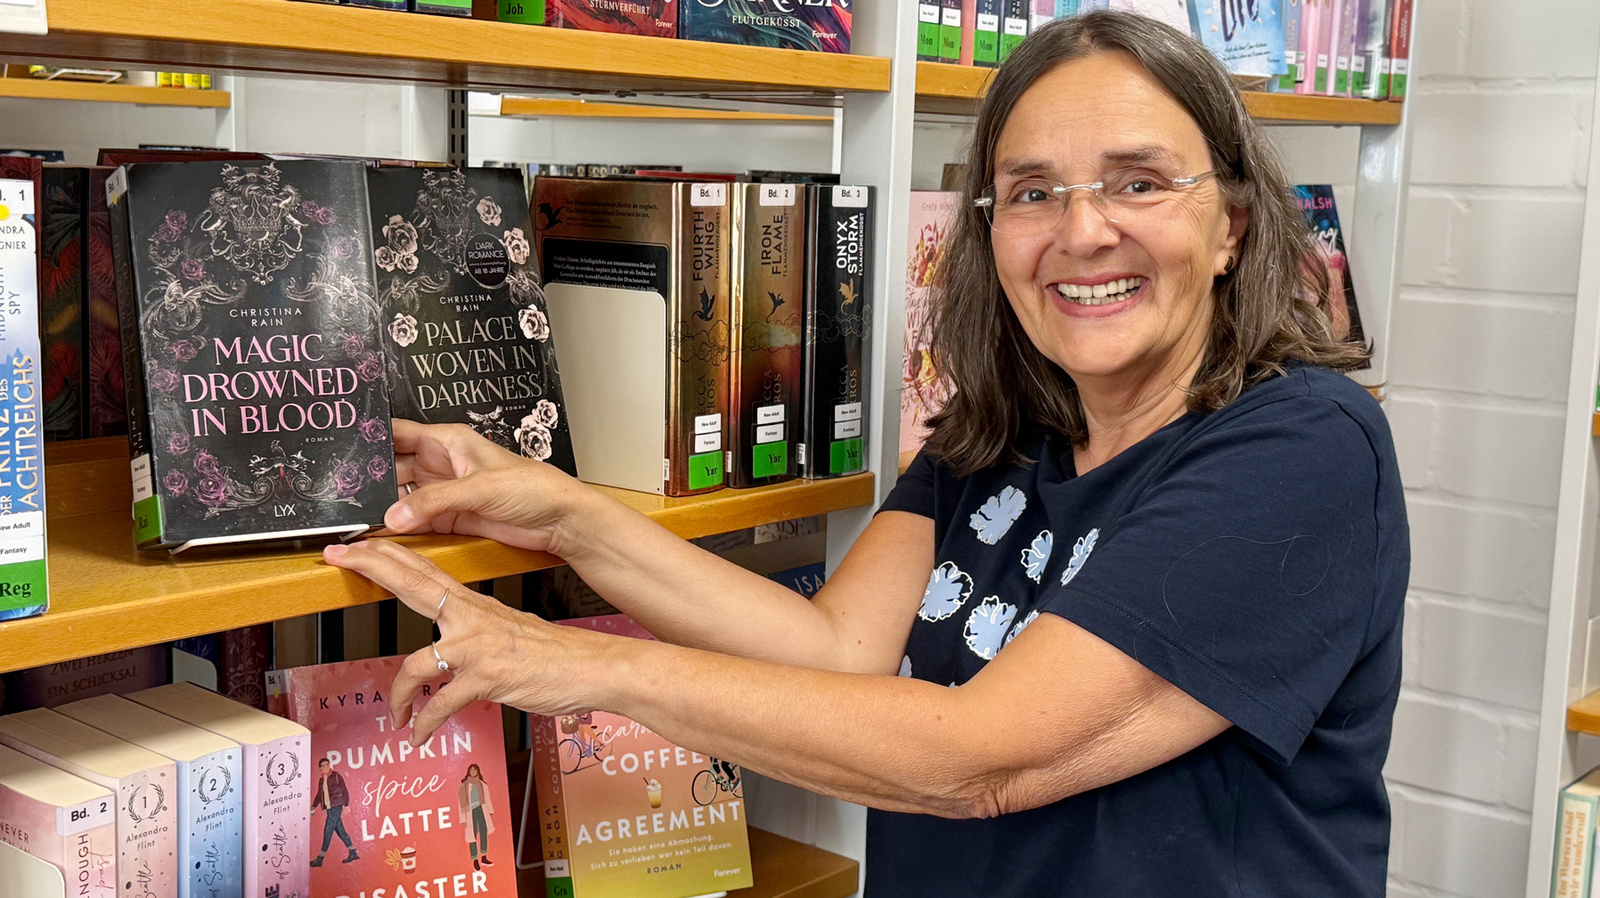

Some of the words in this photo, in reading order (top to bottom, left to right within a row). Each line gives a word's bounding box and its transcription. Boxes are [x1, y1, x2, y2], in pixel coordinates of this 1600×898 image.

[506, 3, 524, 15] Joh
[590, 0, 650, 15] STURMVERFÜHRT
[656, 19, 674, 28] Forever
[732, 15, 801, 28] FLUTGEKÜSST
[812, 30, 838, 39] Forever
[920, 34, 933, 46] Mon
[980, 40, 992, 51] Mon
[18, 190, 24, 201] 1
[700, 189, 710, 198] Bd.
[716, 189, 720, 198] 1
[768, 190, 778, 198] Bd.
[842, 190, 852, 198] Bd.
[475, 242, 495, 250] DARK
[692, 211, 704, 282] FOURTH
[704, 221, 715, 270] WING
[760, 224, 771, 266] IRON
[772, 214, 784, 275] FLAME
[836, 220, 848, 269] ONYX
[848, 214, 859, 275] STORM
[468, 250, 504, 259] ROMANCE
[9, 291, 20, 314] SPY
[440, 294, 492, 305] CHRISTINA
[230, 308, 302, 318] CHRISTINA
[456, 304, 480, 312] RAIN
[251, 318, 283, 326] RAIN
[424, 316, 516, 347] PALACE
[214, 334, 325, 366] MAGIC
[411, 347, 506, 379] WOVEN
[512, 345, 537, 369] IN
[182, 367, 358, 402] DROWNED
[417, 372, 543, 410] DARKNESS
[764, 369, 772, 403] CCA
[191, 407, 227, 437] IN
[240, 400, 357, 435] BLOOD
[13, 355, 39, 511] ACHTREICHS
[769, 454, 781, 464] Yar
[847, 449, 858, 459] Yar
[705, 466, 718, 476] Yar
[274, 504, 296, 517] LYX
[138, 515, 148, 530] Rai
[0, 582, 31, 598] Reg
[794, 572, 826, 594] ISA
[47, 684, 68, 699] EIN
[320, 691, 383, 710] KYRA
[326, 731, 472, 770] PUMPKIN
[278, 763, 285, 775] 3
[549, 738, 559, 794] COFFEE
[602, 746, 703, 776] COFFEE
[209, 779, 217, 792] 2
[142, 796, 147, 809] 1
[263, 792, 302, 808] Alexandra
[362, 774, 447, 818] spice
[71, 808, 90, 822] Bd.
[100, 802, 107, 813] 2
[196, 807, 234, 824] Alexandra
[274, 806, 290, 815] Flint
[206, 822, 222, 832] Flint
[362, 806, 452, 842] LATTE
[576, 801, 740, 845] AGREEMENT
[126, 826, 168, 843] Alexandra
[546, 808, 555, 858] KYRA
[553, 805, 563, 859] GROH
[137, 841, 155, 850] Flint
[271, 825, 291, 868] Seattle
[623, 845, 646, 854] haben
[668, 834, 714, 846] Abmachung.
[204, 842, 223, 886] Seattle
[590, 860, 606, 870] Sich
[620, 854, 655, 865] verlieben
[675, 847, 690, 856] kein
[693, 844, 706, 853] Teil
[708, 842, 734, 851] davon.
[78, 834, 89, 897] NOUGH
[647, 863, 682, 874] ROMAN
[714, 868, 741, 877] Forever
[554, 885, 568, 896] Gro
